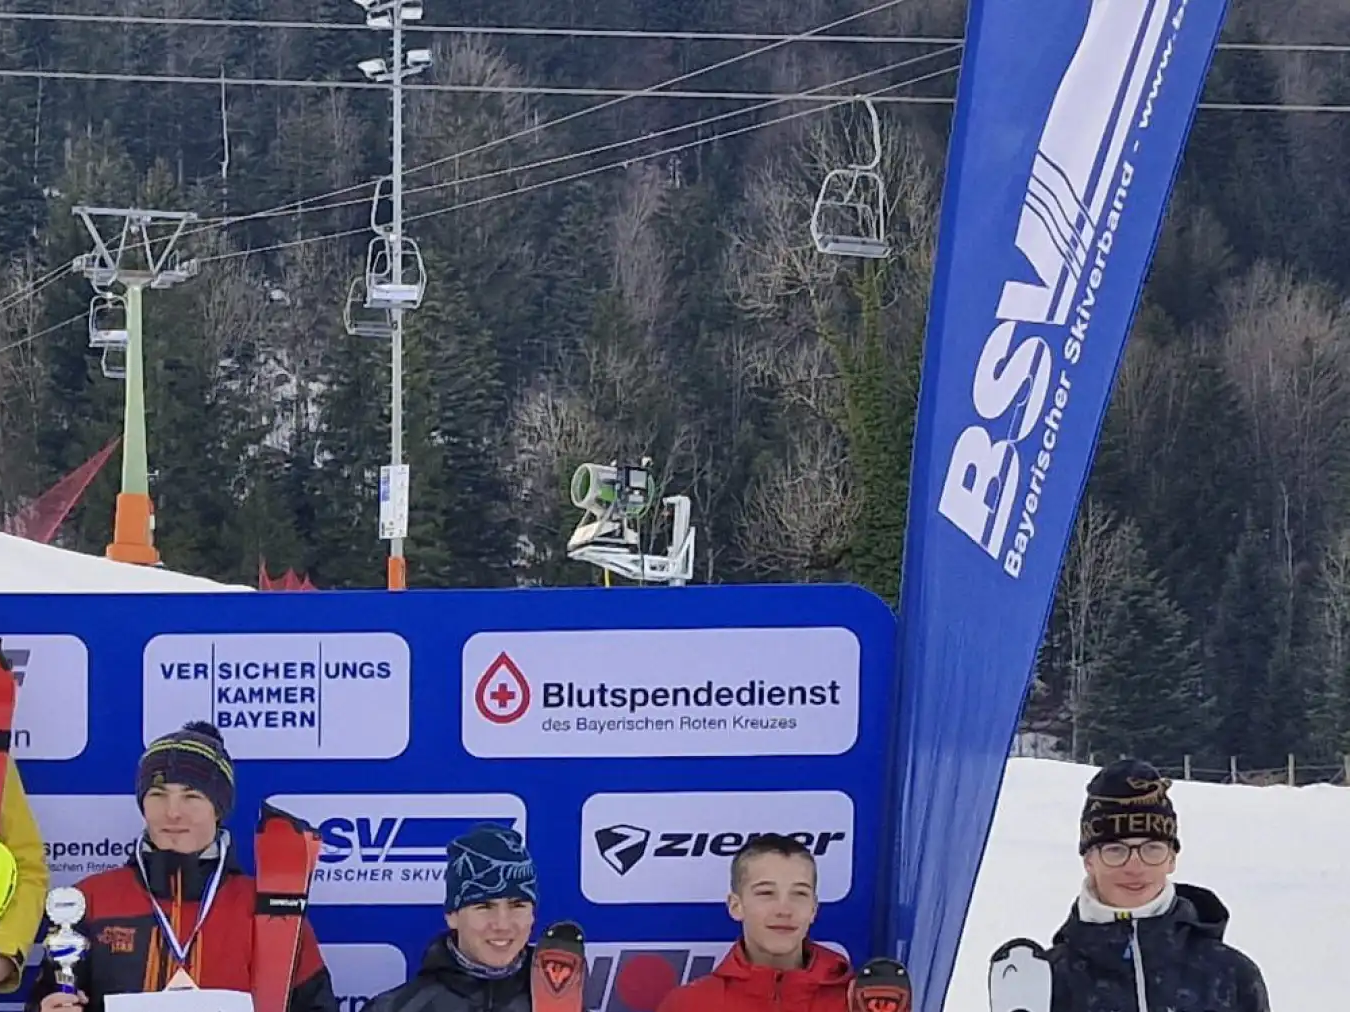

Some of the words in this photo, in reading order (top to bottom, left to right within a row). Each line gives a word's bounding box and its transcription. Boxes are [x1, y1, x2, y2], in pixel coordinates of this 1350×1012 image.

[1003, 369, 1073, 580] Bayerischer
[1063, 160, 1135, 365] Skiverband
[160, 662, 209, 680] VER
[218, 662, 316, 680] SICHER
[324, 662, 391, 680] UNGS
[217, 686, 316, 704] KAMMER
[543, 680, 841, 712] Blutspendedienst
[217, 710, 316, 729] BAYERN
[541, 717, 572, 732] des
[576, 716, 675, 734] Bayerischen
[679, 715, 727, 730] Roten
[732, 715, 798, 730] Kreuzes
[319, 817, 399, 864] SV
